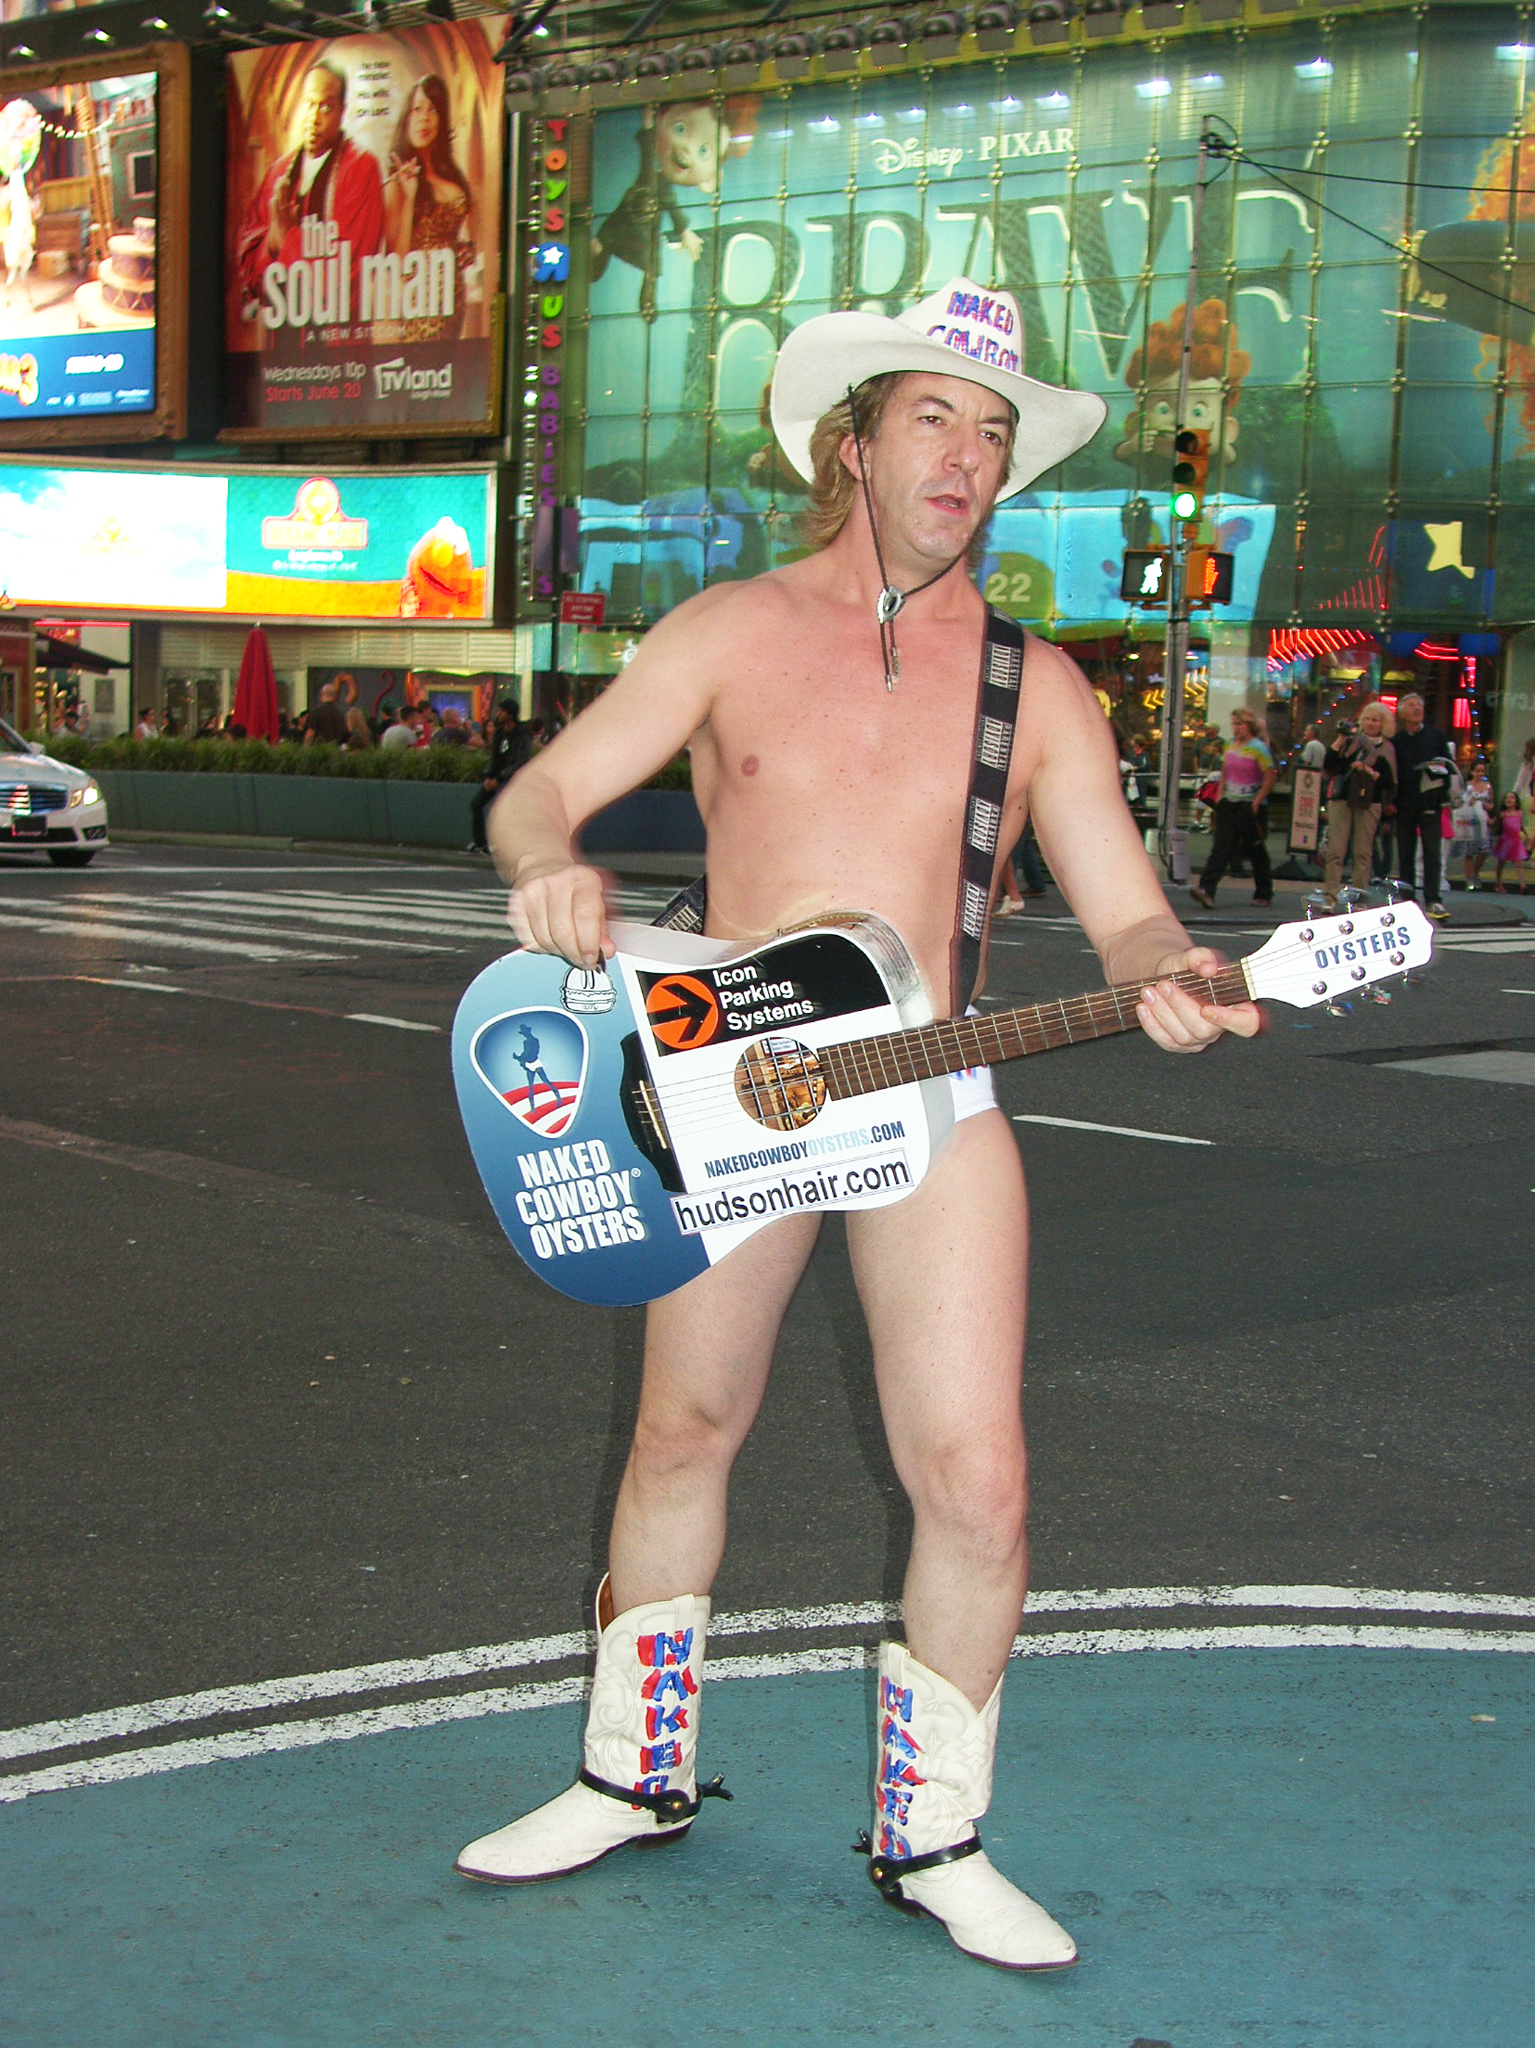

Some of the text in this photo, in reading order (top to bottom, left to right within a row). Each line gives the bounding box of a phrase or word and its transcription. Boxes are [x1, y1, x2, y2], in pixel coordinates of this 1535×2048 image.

[544, 119, 567, 232] TOYS
[871, 128, 1076, 177] Disney PIXAR
[301, 213, 339, 259] the
[261, 240, 456, 329] soul man
[306, 330, 316, 342] A
[320, 327, 350, 341] NEW
[541, 294, 564, 348] US
[946, 290, 1014, 336] NAKED
[264, 361, 367, 382] Wednesdays 10p
[266, 382, 361, 402] Starts June 20
[988, 573, 1032, 602] 22
[990, 644, 1011, 687] ADVISORY
[981, 717, 1003, 768] ADVISORY
[971, 798, 991, 852] ADVISORY
[963, 882, 980, 938] ADVISORY
[1314, 926, 1411, 969] OYSTERS
[712, 965, 758, 987] Icon
[718, 980, 795, 1010] Parking
[726, 1000, 814, 1031] Systems
[516, 1139, 611, 1188] NAKED
[704, 1120, 906, 1178] NAKEDCOWBOYOYSTERS.COM
[675, 1160, 910, 1231] hudsonhair.com
[530, 1205, 646, 1260] OYSTERS
